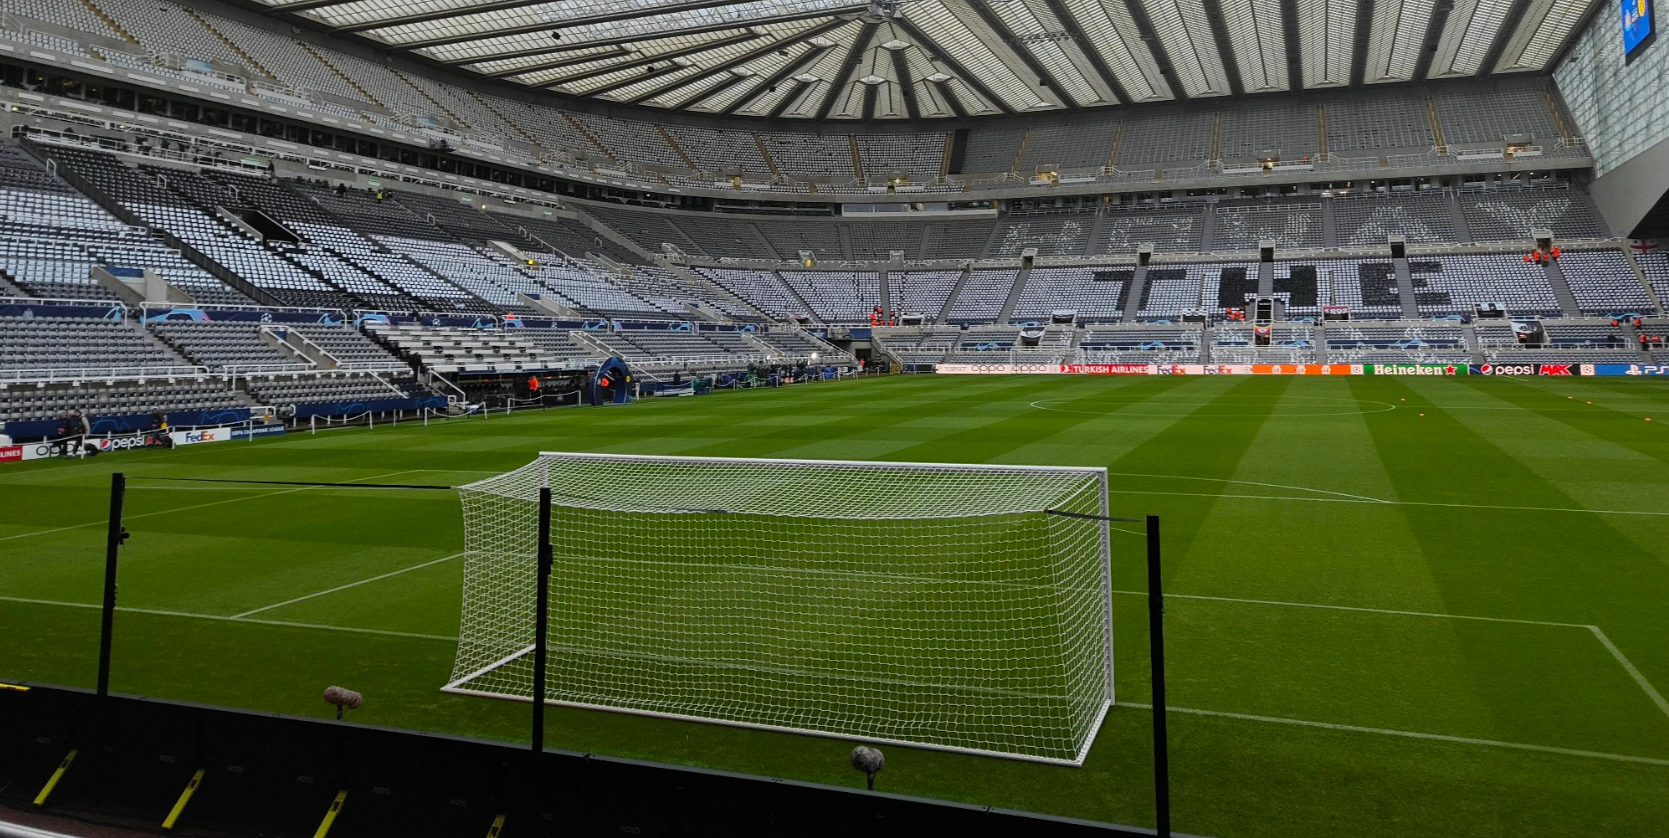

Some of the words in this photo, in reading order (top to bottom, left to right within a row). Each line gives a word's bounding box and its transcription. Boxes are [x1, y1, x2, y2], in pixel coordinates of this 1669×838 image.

[1093, 261, 1452, 312] THE
[971, 364, 1005, 374] oppo
[1012, 364, 1046, 374] oppo
[1073, 365, 1109, 374] TURKISH
[1110, 365, 1149, 374] AIRLINES
[1157, 365, 1186, 375] FedEx
[1203, 365, 1232, 375] FedEx
[1373, 364, 1443, 375] Heineken
[1495, 364, 1535, 376] pepsi
[1539, 364, 1573, 376] MAX
[243, 427, 268, 435] CHMPIONS
[185, 430, 214, 443] FedEx
[111, 435, 145, 452] pepsi
